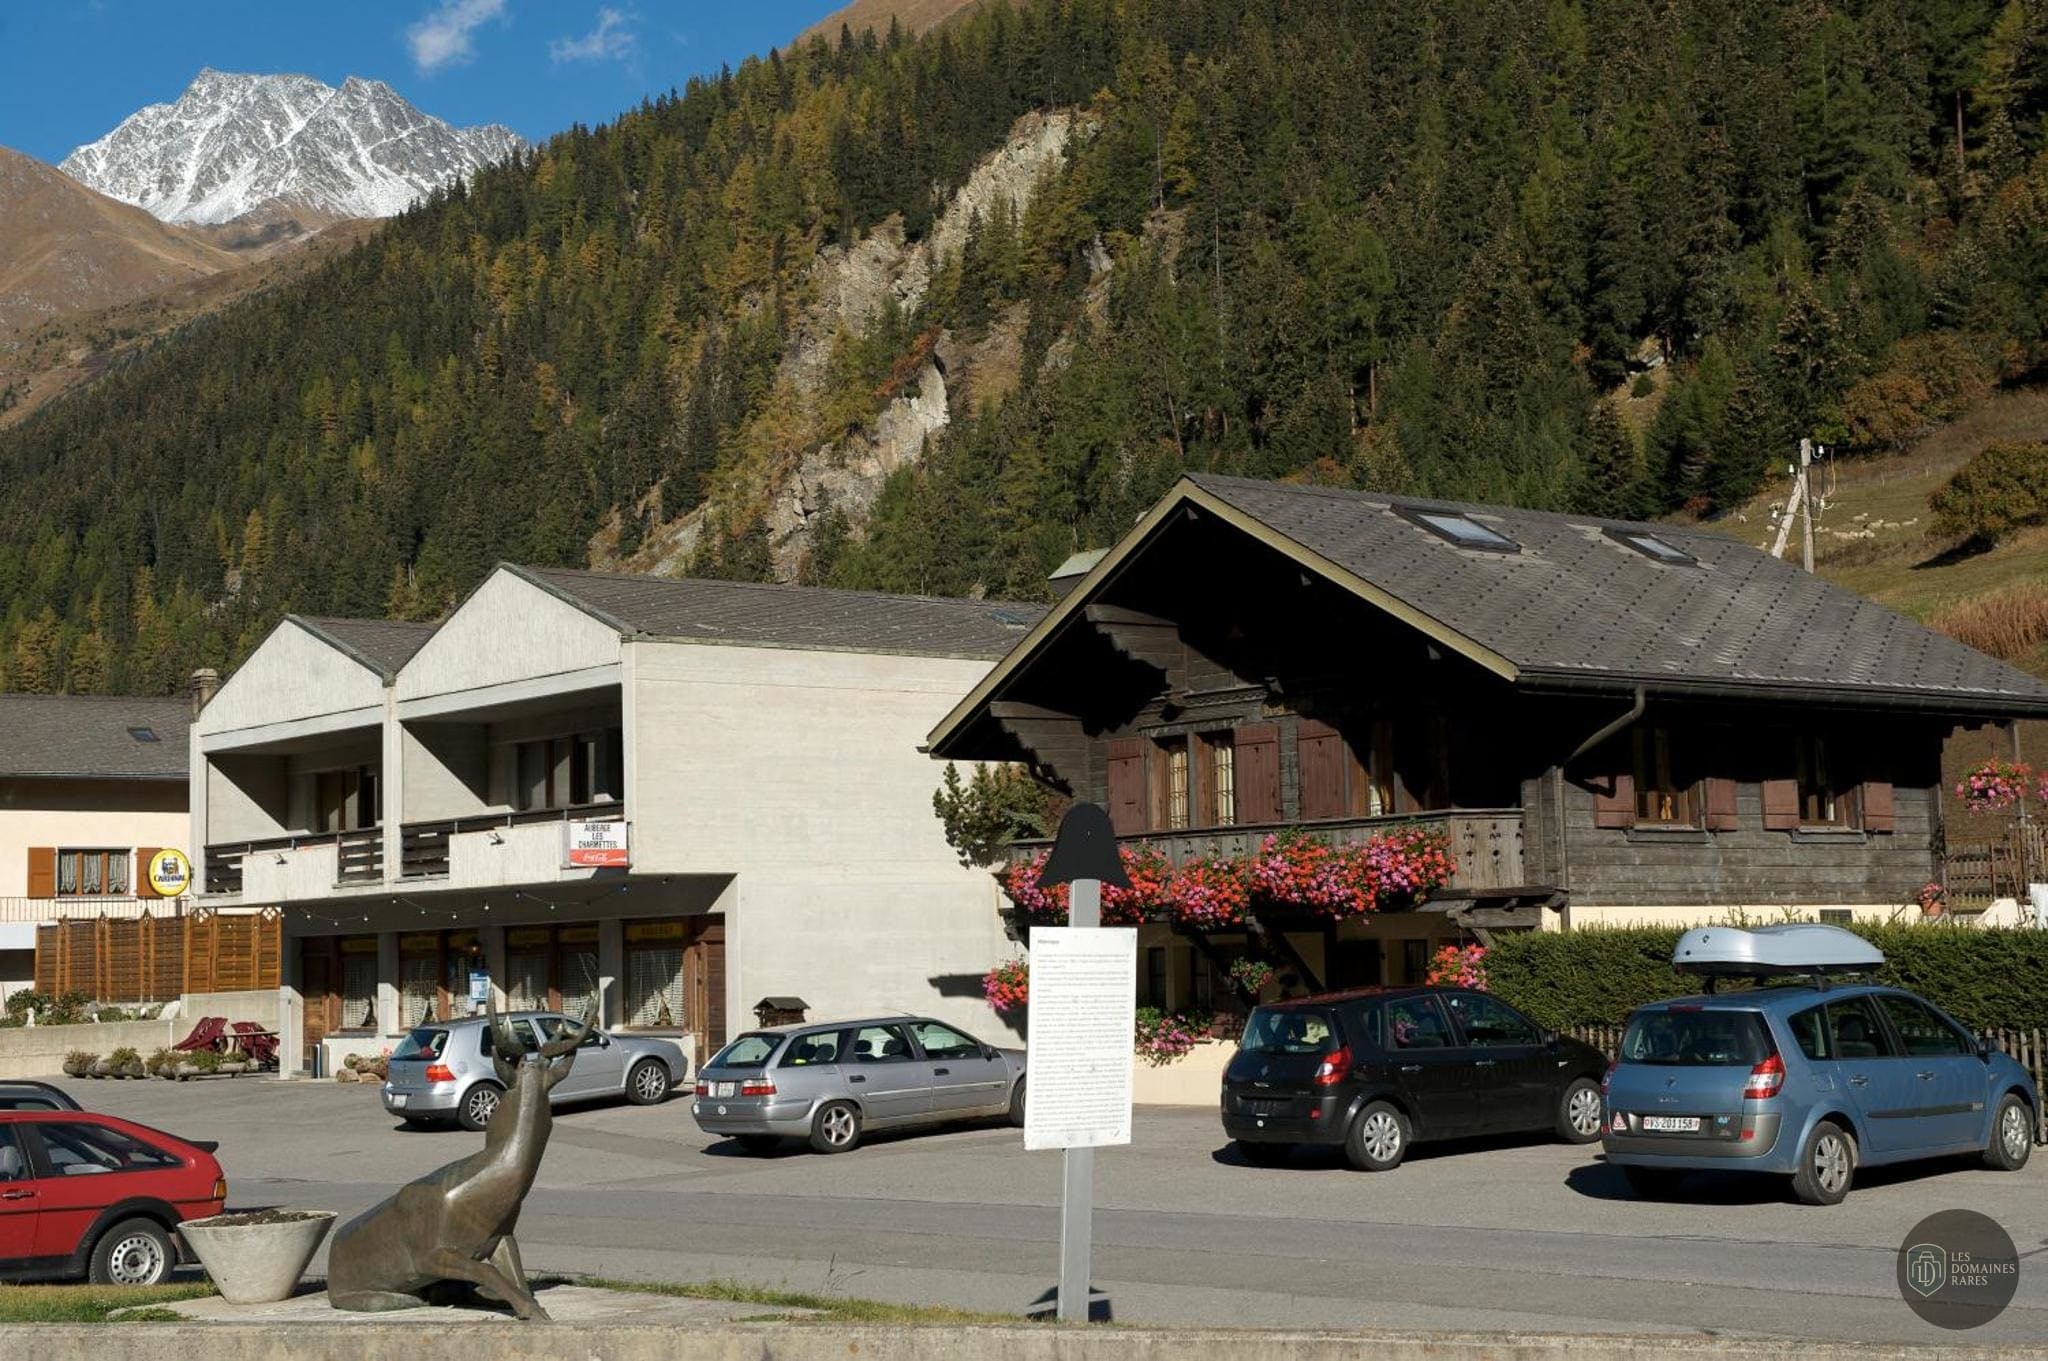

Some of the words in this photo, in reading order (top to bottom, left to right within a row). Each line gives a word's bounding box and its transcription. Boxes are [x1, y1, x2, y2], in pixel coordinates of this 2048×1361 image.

[584, 823, 611, 832] AUBERGE
[592, 832, 604, 840] LES
[578, 840, 618, 849] CHARMETTES
